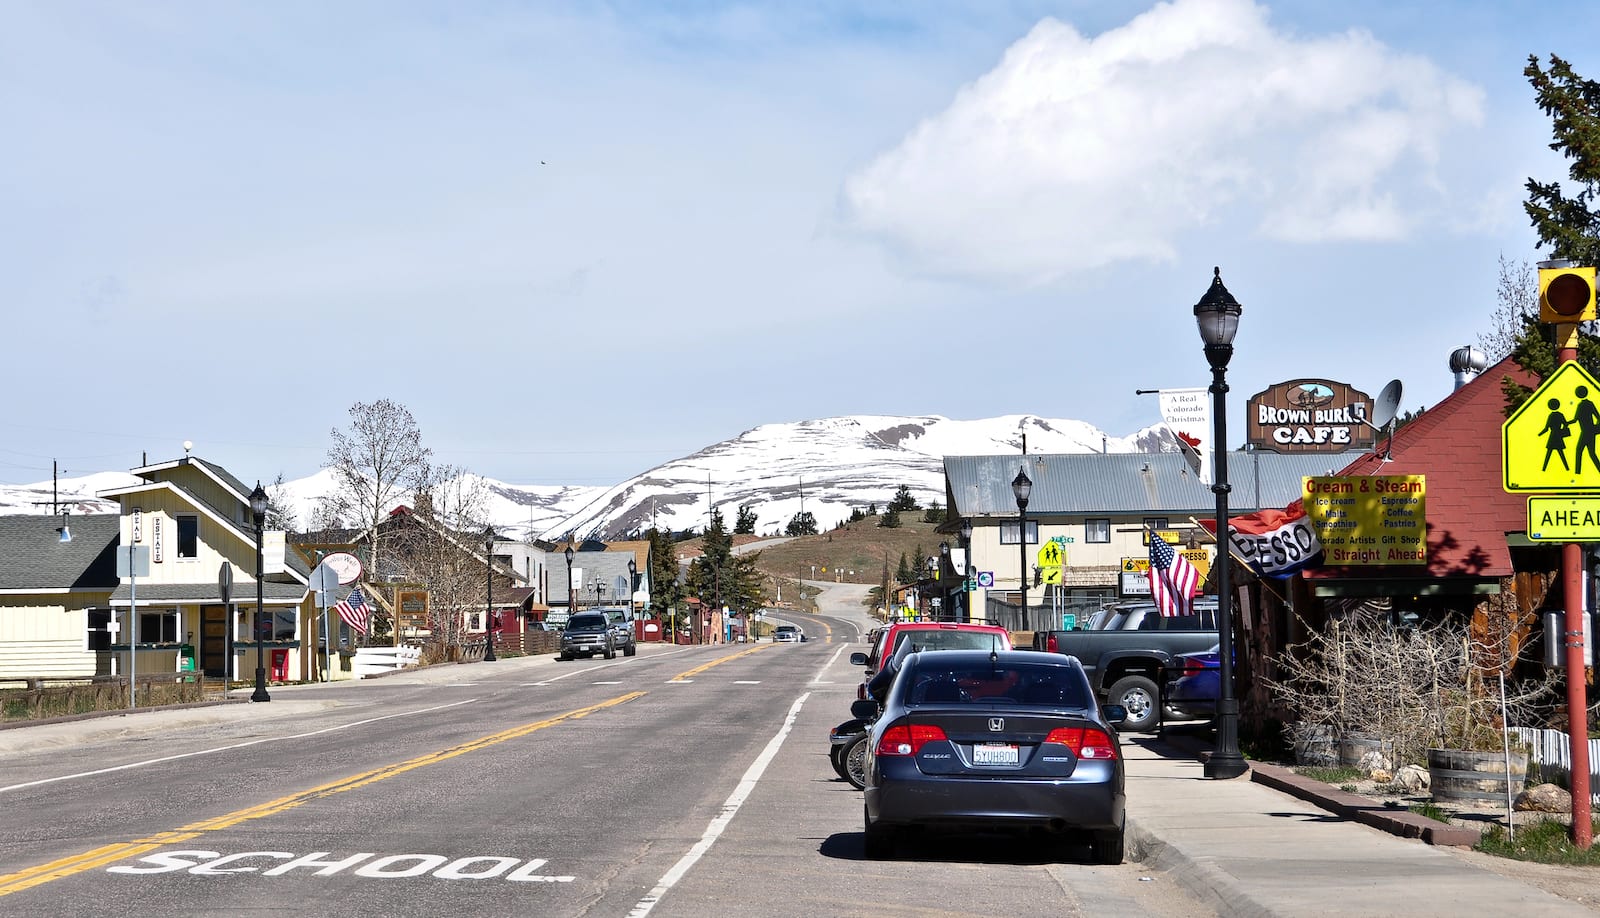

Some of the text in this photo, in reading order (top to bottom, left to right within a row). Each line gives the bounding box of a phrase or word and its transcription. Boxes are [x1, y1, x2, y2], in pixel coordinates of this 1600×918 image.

[1259, 404, 1310, 424] BROWN
[1272, 426, 1351, 444] CAFE
[1306, 480, 1422, 493] Cream & Steam
[1316, 498, 1355, 506] Ice cream
[1381, 497, 1418, 507] Espresso
[1325, 510, 1347, 518] Malts
[1387, 508, 1413, 516] Coffee
[1384, 519, 1416, 528] Pastries
[1541, 510, 1600, 527] AHEA
[1316, 520, 1357, 528] Smoothies
[1349, 536, 1376, 544] Artists
[1382, 536, 1396, 544] Gift
[1400, 536, 1421, 546] Shop
[1333, 548, 1380, 563] Straight
[1387, 548, 1424, 561] Ahead
[106, 850, 577, 882] SCHOOL
